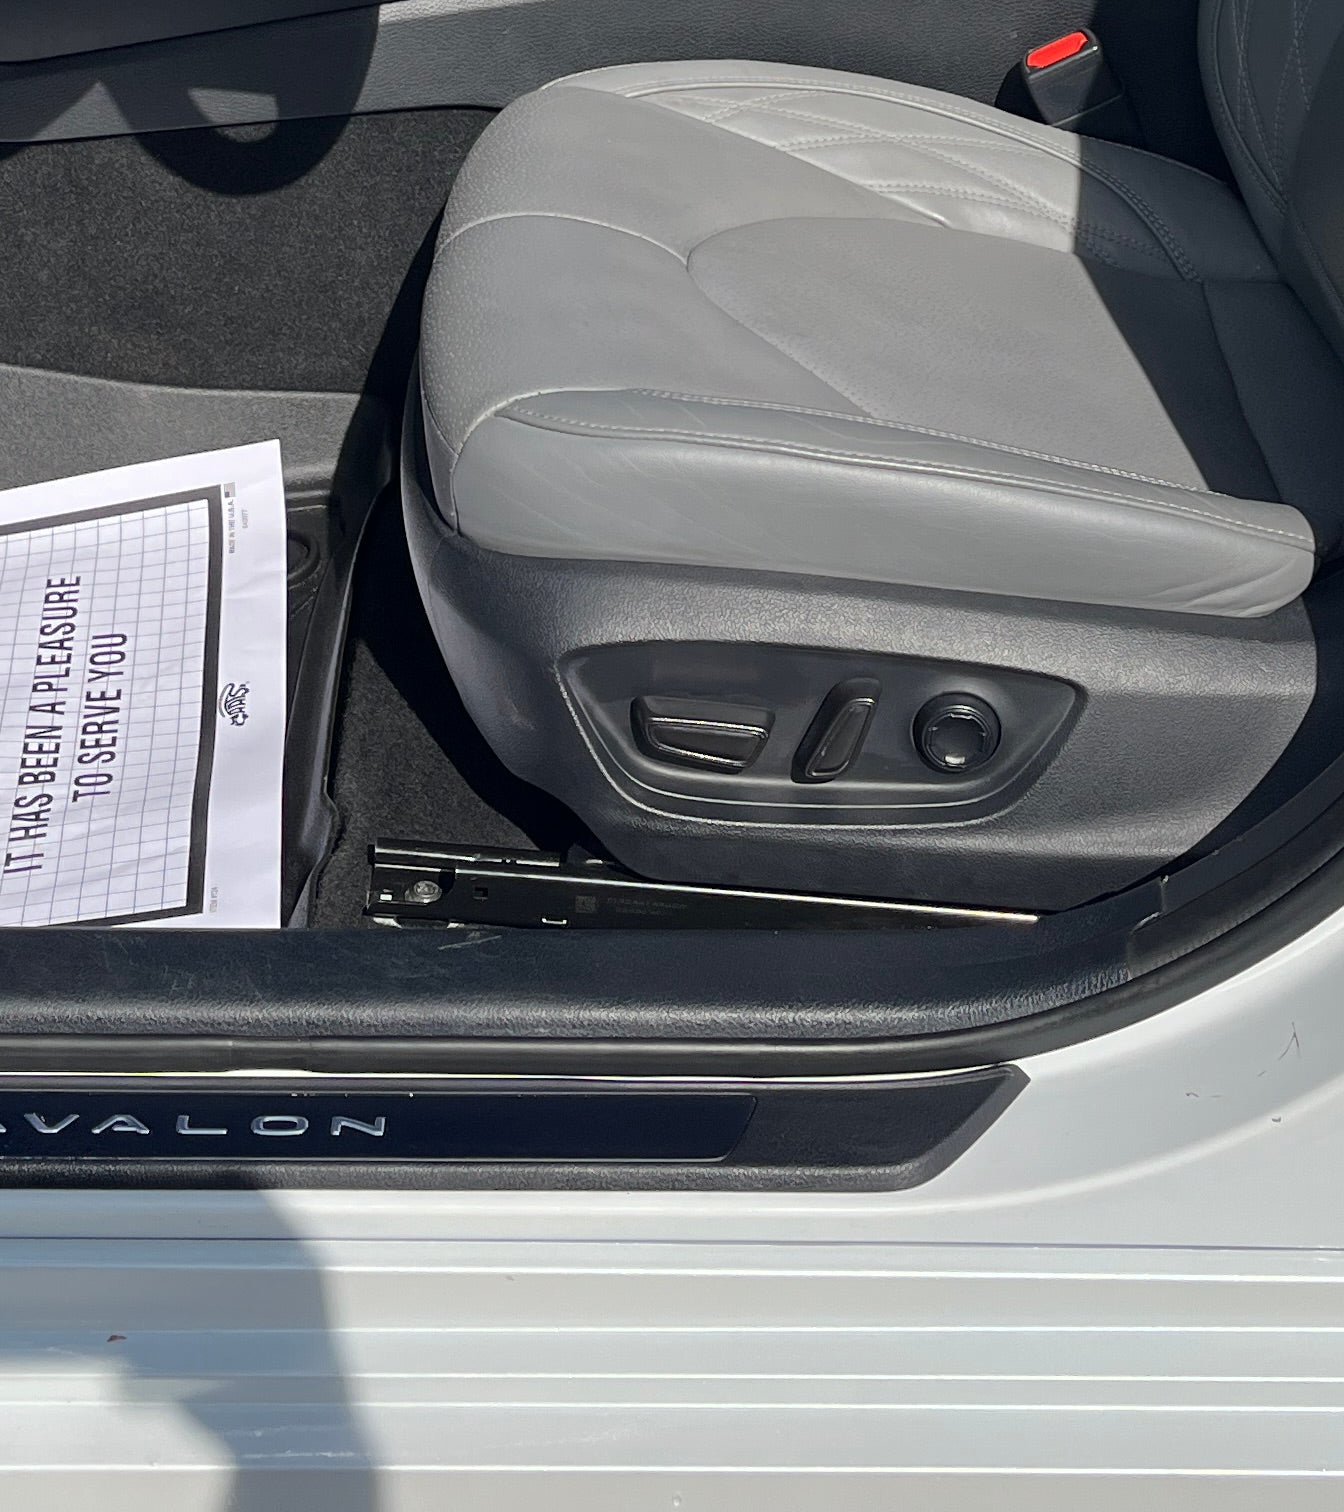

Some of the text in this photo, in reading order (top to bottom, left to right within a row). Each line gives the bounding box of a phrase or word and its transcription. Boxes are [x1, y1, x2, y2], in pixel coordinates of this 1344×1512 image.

[3, 576, 81, 874] IT HAS BEEN A PLEASURE
[72, 634, 127, 802] TO SERVE YOU
